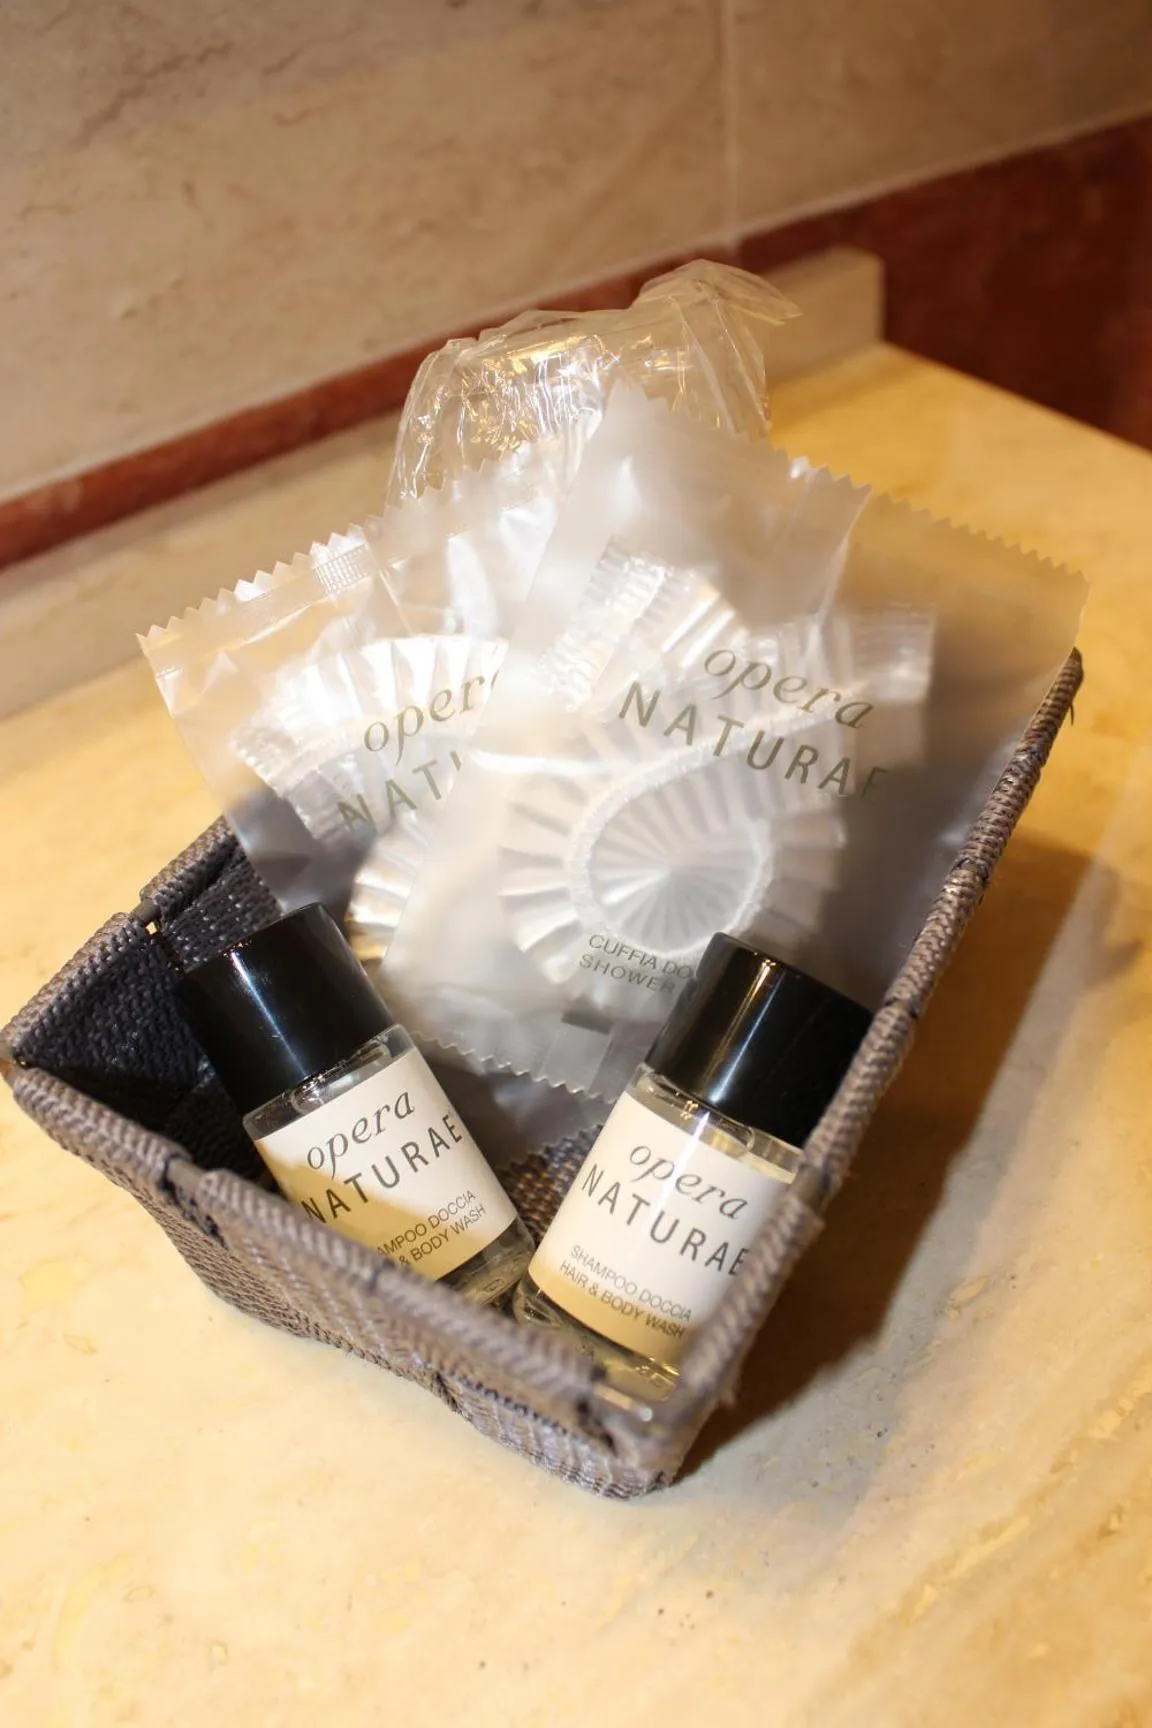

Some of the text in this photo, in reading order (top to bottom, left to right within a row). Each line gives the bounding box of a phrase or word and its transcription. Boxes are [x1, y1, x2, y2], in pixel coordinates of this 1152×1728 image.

[364, 669, 499, 766] oper
[704, 649, 874, 729] opera
[337, 750, 463, 832] NAT
[579, 954, 675, 993] SHOWER
[589, 934, 693, 979] CUFFIA DO
[300, 1114, 462, 1223] NATURAE
[307, 1092, 415, 1180] opera
[629, 1145, 748, 1219] opera
[377, 1190, 476, 1256] AMPOO DOCCIA
[410, 1229, 449, 1261] BODY
[450, 1204, 486, 1235] WASH
[561, 1261, 685, 1339] HAIR & BODY WASH
[570, 1245, 692, 1321] SHAMPOO DOCCIA
